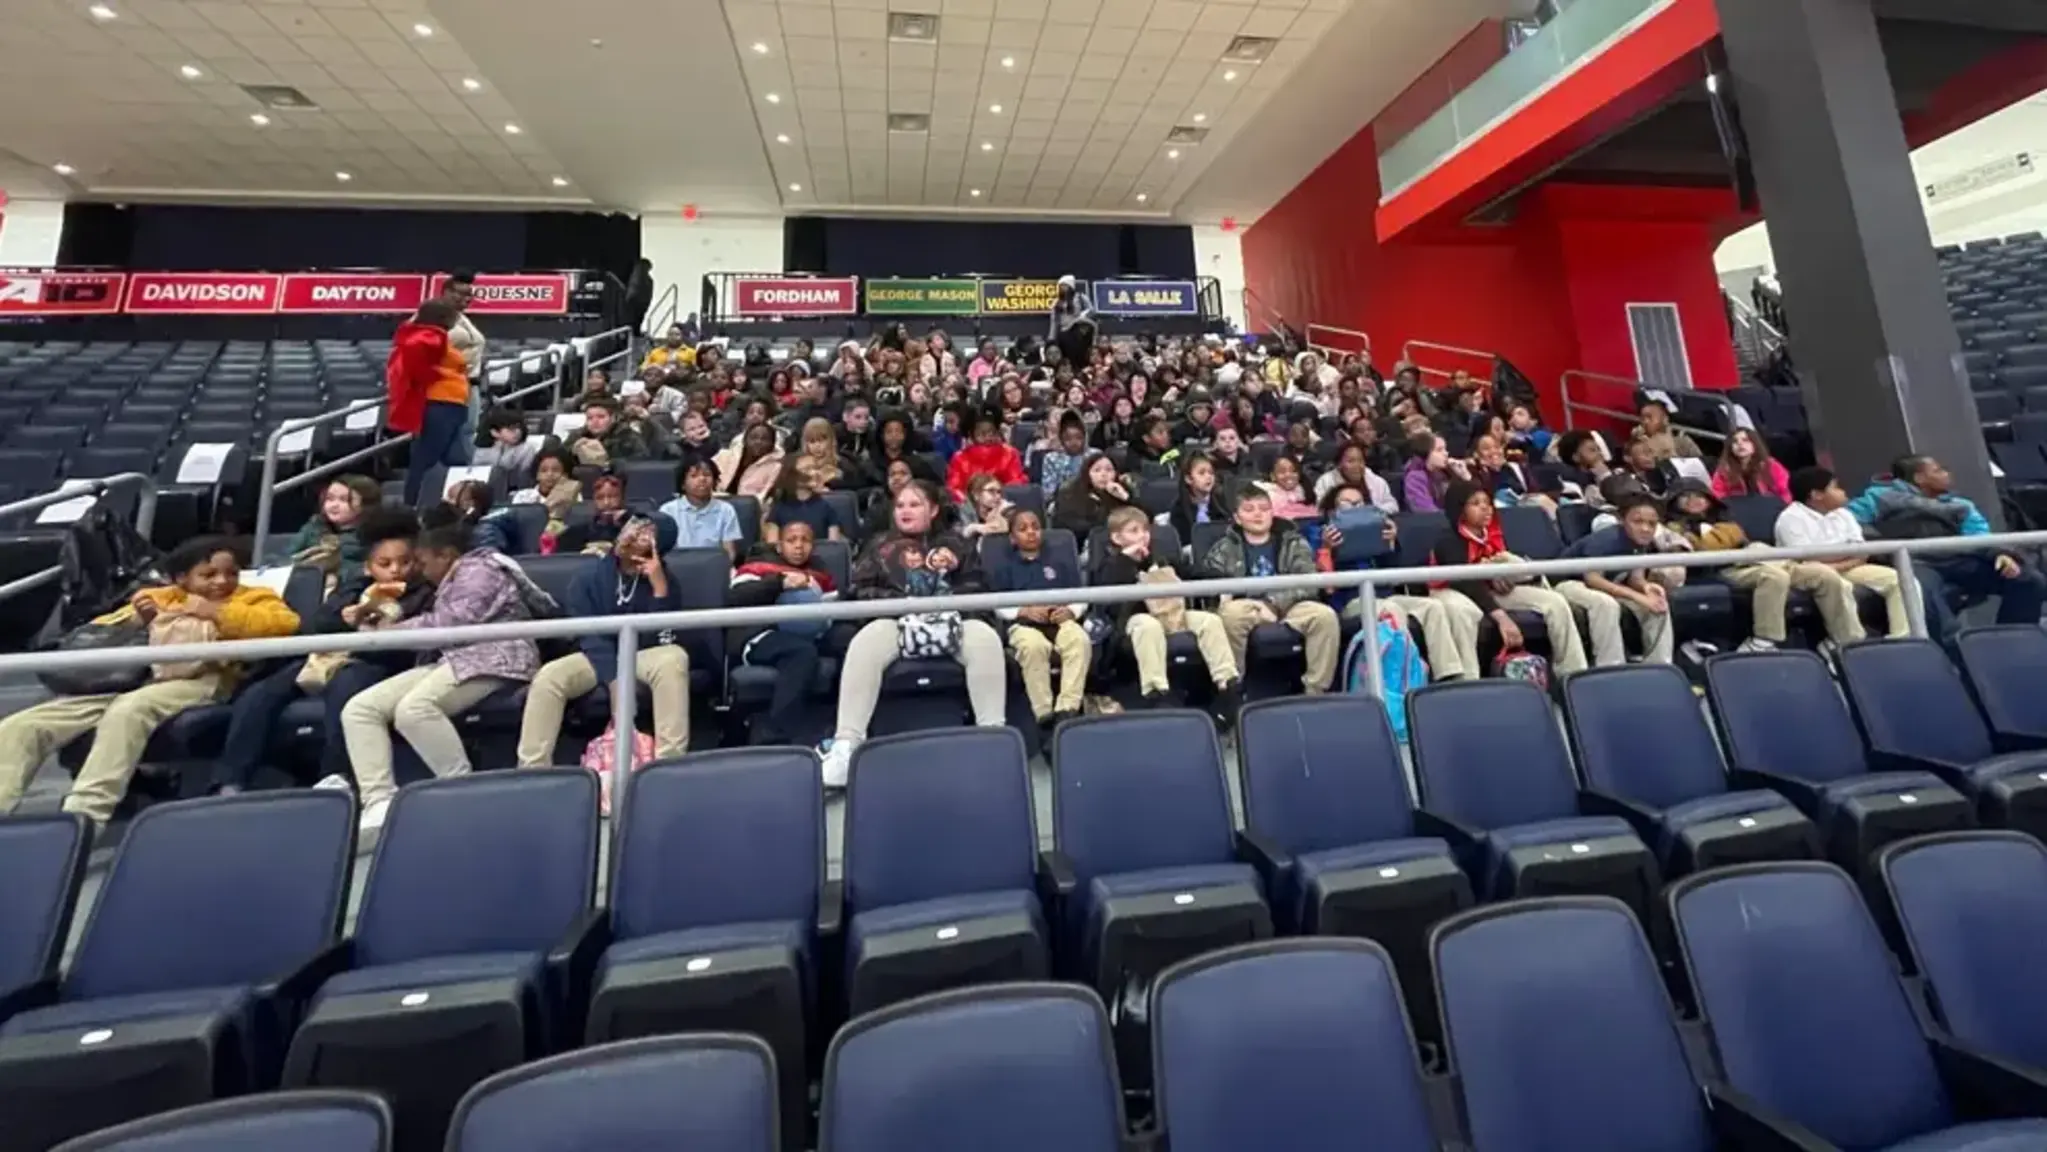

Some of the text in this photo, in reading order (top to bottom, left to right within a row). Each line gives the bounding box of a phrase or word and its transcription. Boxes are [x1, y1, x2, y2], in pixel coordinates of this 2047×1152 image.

[142, 284, 265, 301] DAVIDSON
[312, 286, 396, 301] DAYTON
[472, 286, 554, 303] QUESNE
[753, 289, 840, 303] FORDHAM
[870, 290, 976, 300] GEORGE MASON
[1004, 284, 1060, 297] GEORG
[1108, 290, 1131, 304] LA
